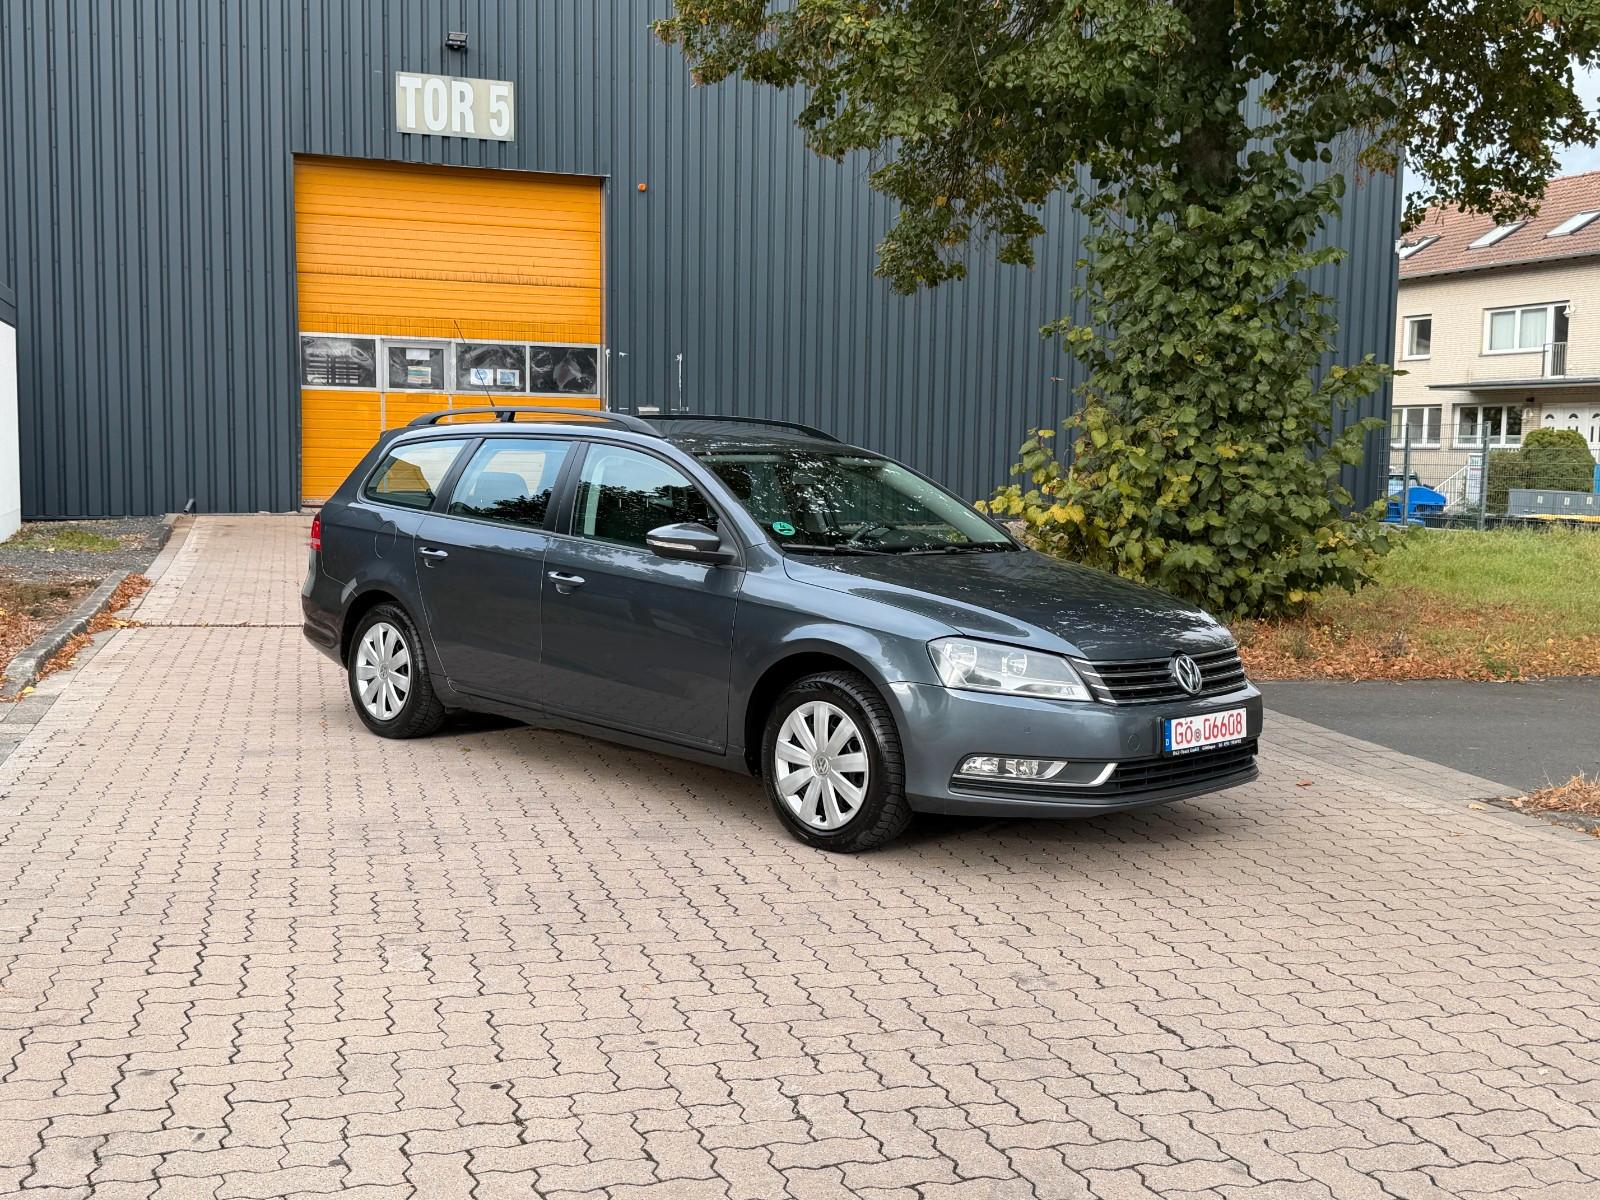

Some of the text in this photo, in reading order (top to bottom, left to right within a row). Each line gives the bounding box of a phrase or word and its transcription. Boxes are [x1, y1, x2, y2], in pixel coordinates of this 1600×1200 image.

[399, 76, 510, 137] TOR 5
[1174, 712, 1243, 745] GÖ 06608
